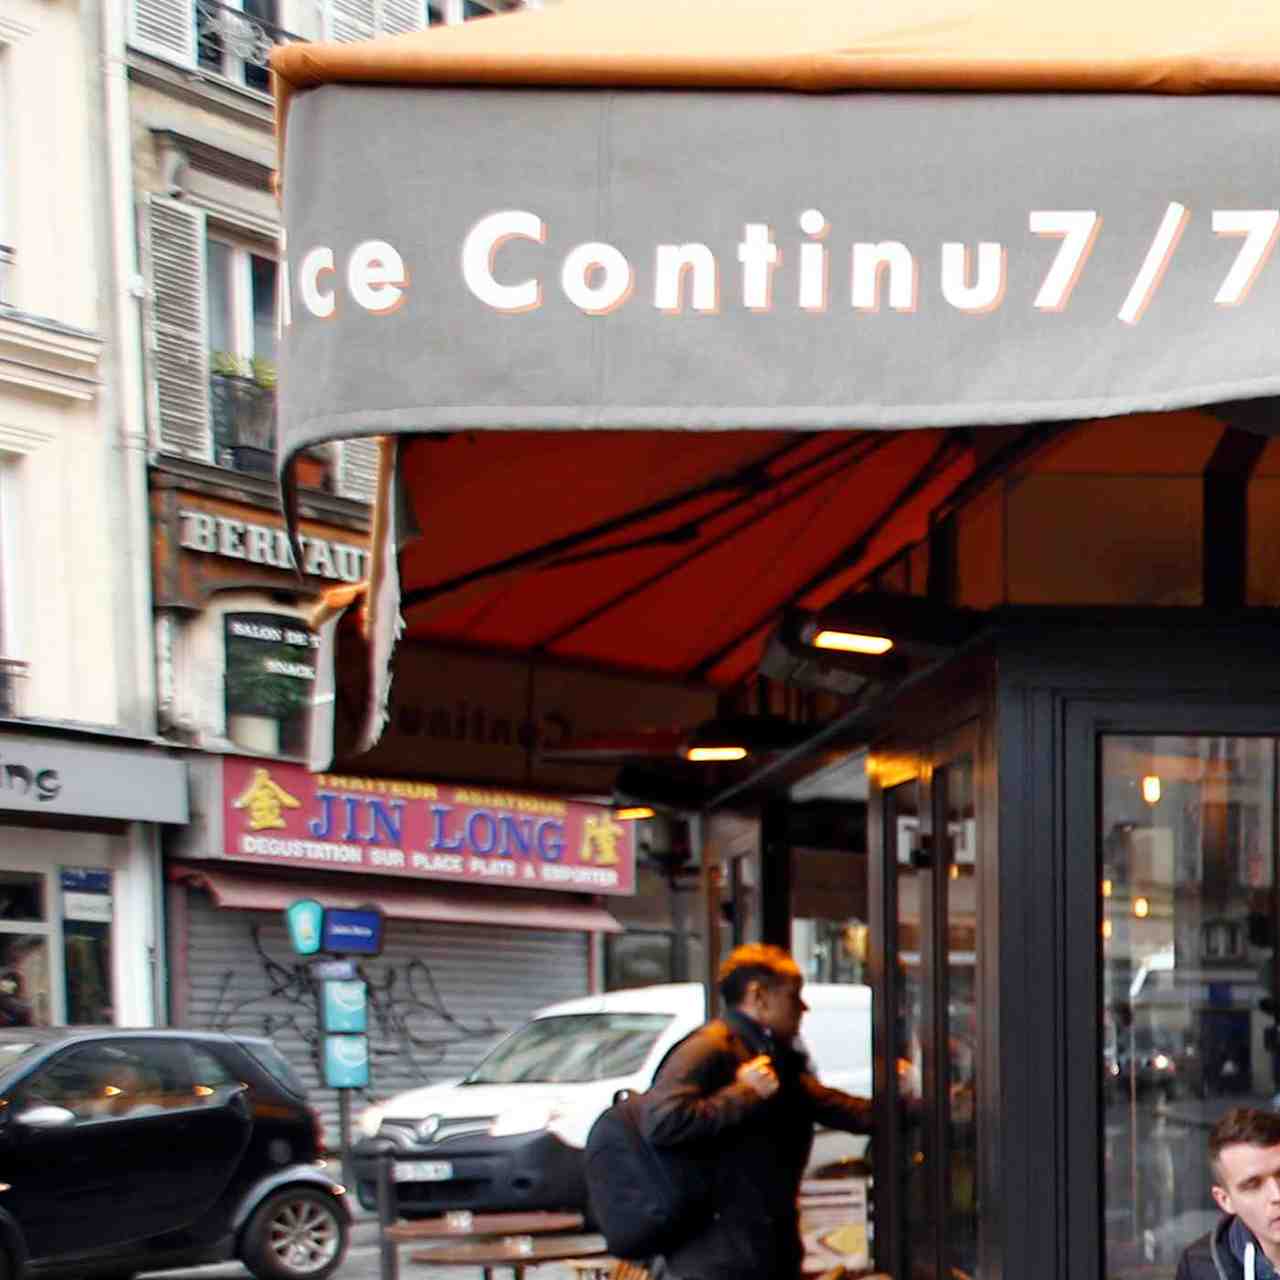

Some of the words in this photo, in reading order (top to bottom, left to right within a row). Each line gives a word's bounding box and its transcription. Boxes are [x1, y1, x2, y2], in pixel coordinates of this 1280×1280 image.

[282, 236, 408, 328] ce
[0, 763, 63, 802] ng
[233, 767, 301, 832] 金
[241, 834, 363, 863] DEGUSTATION
[369, 847, 406, 867] SUR
[412, 851, 464, 873] PLACE
[308, 789, 408, 845] JIN
[429, 803, 569, 864] LONG
